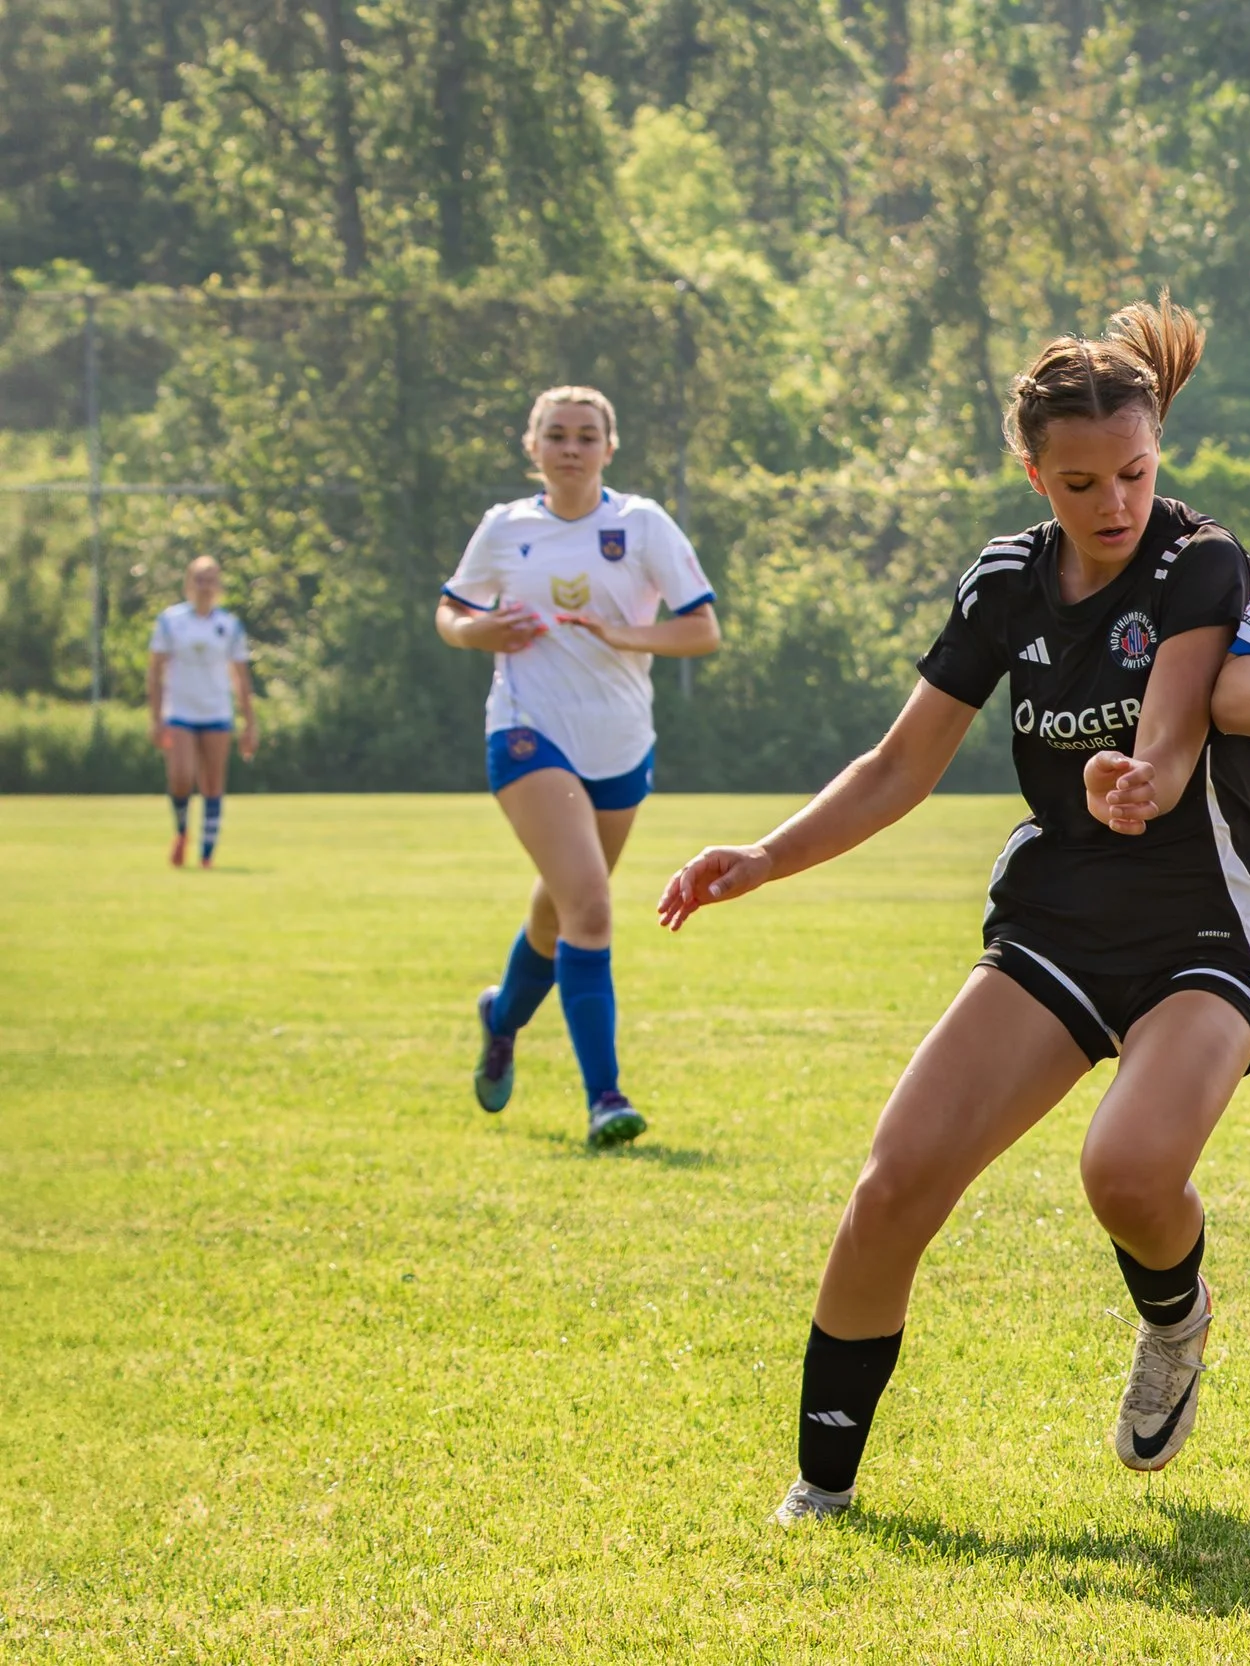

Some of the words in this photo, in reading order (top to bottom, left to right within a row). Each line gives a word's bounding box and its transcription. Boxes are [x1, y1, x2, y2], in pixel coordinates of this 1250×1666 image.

[1110, 611, 1157, 651] NORTHUMBERLAND
[1122, 654, 1151, 669] UNITED
[1039, 697, 1141, 739] ROGER
[1046, 735, 1117, 750] COBOURG
